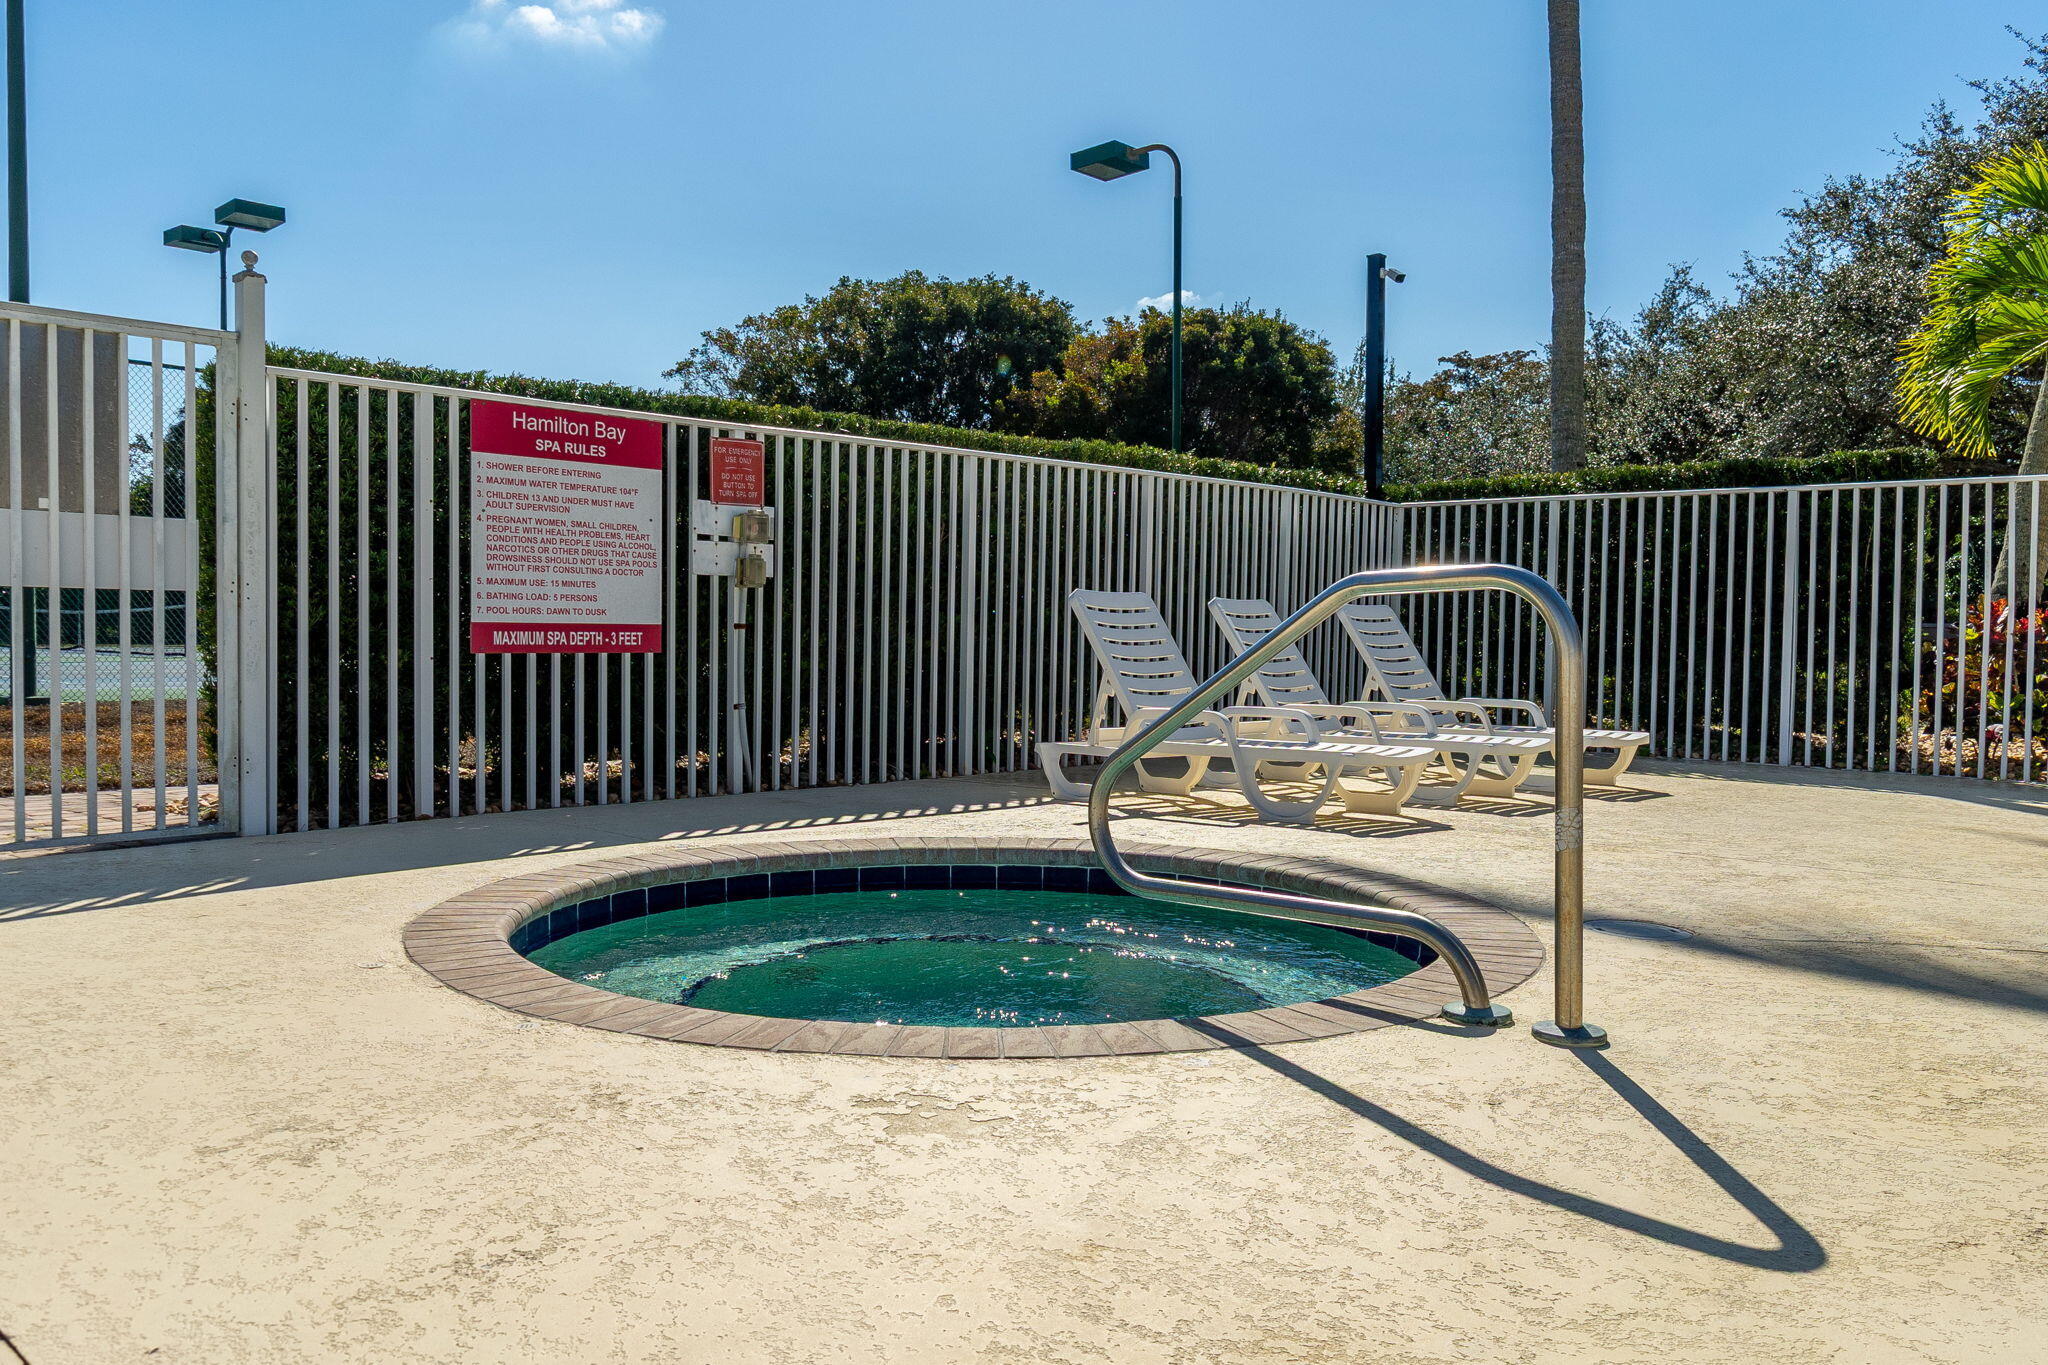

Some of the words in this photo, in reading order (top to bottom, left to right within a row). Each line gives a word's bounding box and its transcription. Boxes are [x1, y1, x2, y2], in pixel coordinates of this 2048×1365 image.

[513, 411, 589, 437] Hamilton
[594, 421, 626, 444] Bay
[536, 439, 561, 453] SPA
[565, 443, 606, 458] RULES
[729, 448, 761, 456] EMERGENCY
[486, 462, 523, 472] SHOWER
[526, 466, 559, 476] BEFORE
[562, 469, 601, 479] ENTERING
[486, 476, 526, 487] MAXIMUM
[529, 480, 558, 490] WATER
[560, 483, 617, 494] TEMPERATURE
[486, 490, 529, 501] CHILDREN
[562, 497, 589, 506] UNDER
[591, 500, 612, 508] MUST
[615, 501, 634, 509] HAVE
[486, 501, 513, 510] ADULT
[516, 503, 570, 513] SUPERVISION
[486, 515, 532, 525] PREGNANT
[535, 518, 568, 528] WOMEN,
[571, 521, 597, 529] SMALL
[599, 522, 639, 532] CHILDREN,
[486, 525, 520, 534] PEOPLE
[522, 527, 543, 535] WITH
[545, 528, 576, 537] HEALTH
[579, 531, 624, 541] PROBLEMS,
[626, 533, 650, 541] HEART
[486, 534, 538, 544] CONDITIONS
[560, 538, 590, 547] PEOPLE
[593, 540, 616, 548] USING
[618, 542, 656, 551] ALCOHOL,
[486, 544, 536, 554] NARCOTICS
[552, 548, 579, 556] OTHER
[581, 549, 608, 557] DRUGS
[611, 550, 630, 558] THAT
[632, 551, 657, 559] CAUSE
[486, 554, 542, 563] DROWSINESS
[544, 557, 578, 565] SHOULD
[632, 560, 657, 568] POOLS
[486, 564, 525, 572] WITHOUT
[552, 566, 603, 575] CONSULTING
[612, 568, 643, 576] DOCTOR
[486, 578, 526, 586] MAXIMUM
[561, 580, 596, 588] MINUTES
[486, 592, 523, 601] BATHING
[493, 631, 544, 646] MAXIMUM
[547, 631, 567, 646] SPA
[570, 632, 602, 645] DEPTH
[611, 632, 616, 645] 3
[619, 632, 643, 646] FEET
